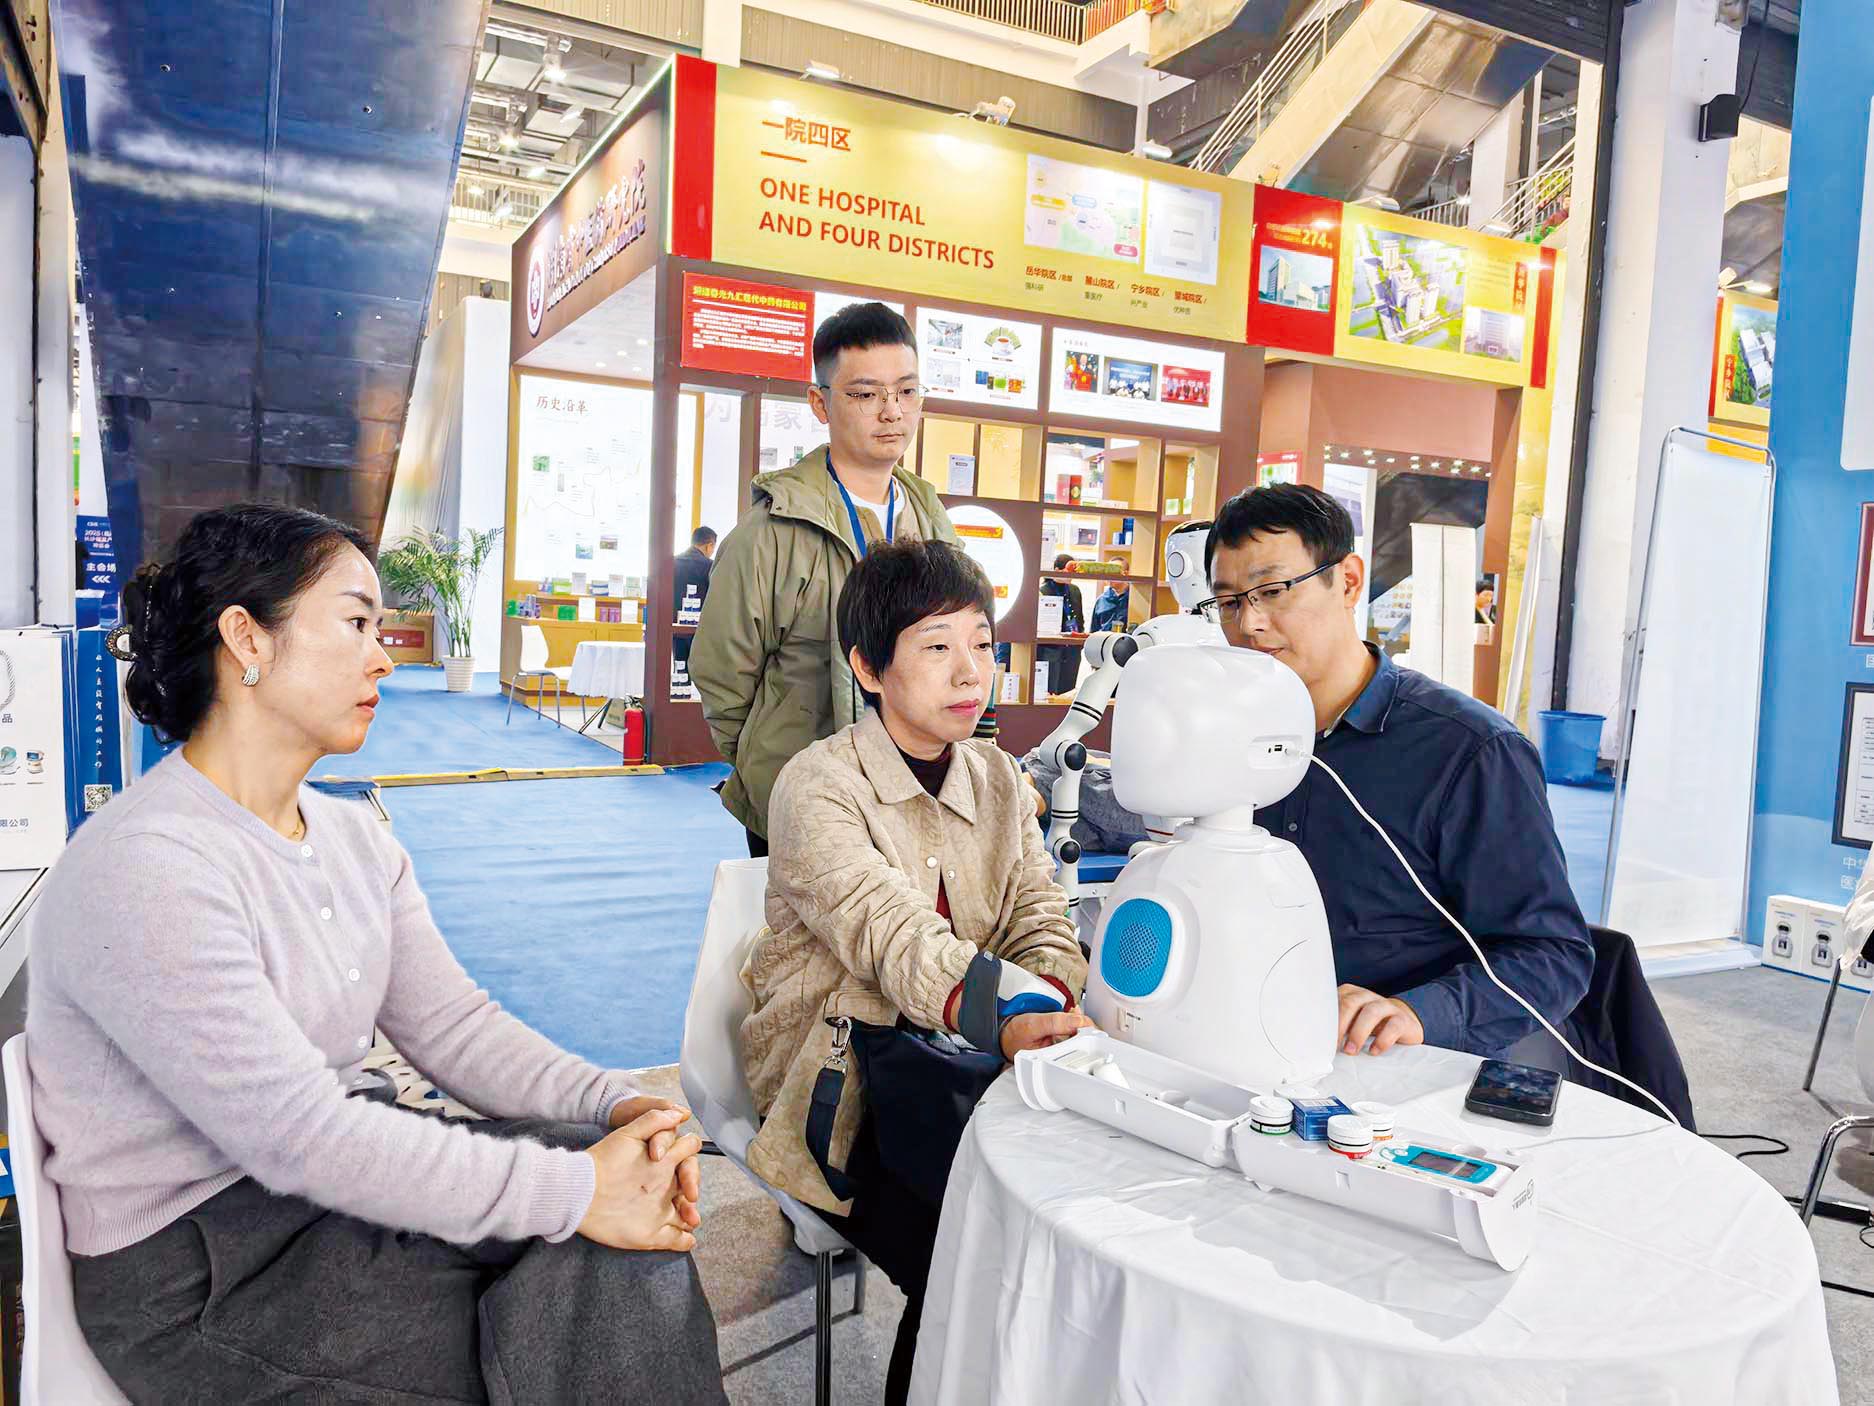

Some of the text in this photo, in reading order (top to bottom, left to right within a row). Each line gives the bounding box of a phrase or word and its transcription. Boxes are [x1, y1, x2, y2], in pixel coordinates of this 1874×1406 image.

[761, 117, 852, 153] 一院四区
[760, 177, 926, 226] ONE HOSPITAL
[759, 210, 995, 270] AND FOUR DISTRICTS
[536, 395, 589, 416] 历史沿革
[86, 562, 117, 573] 主会场
[1, 713, 13, 724] 品
